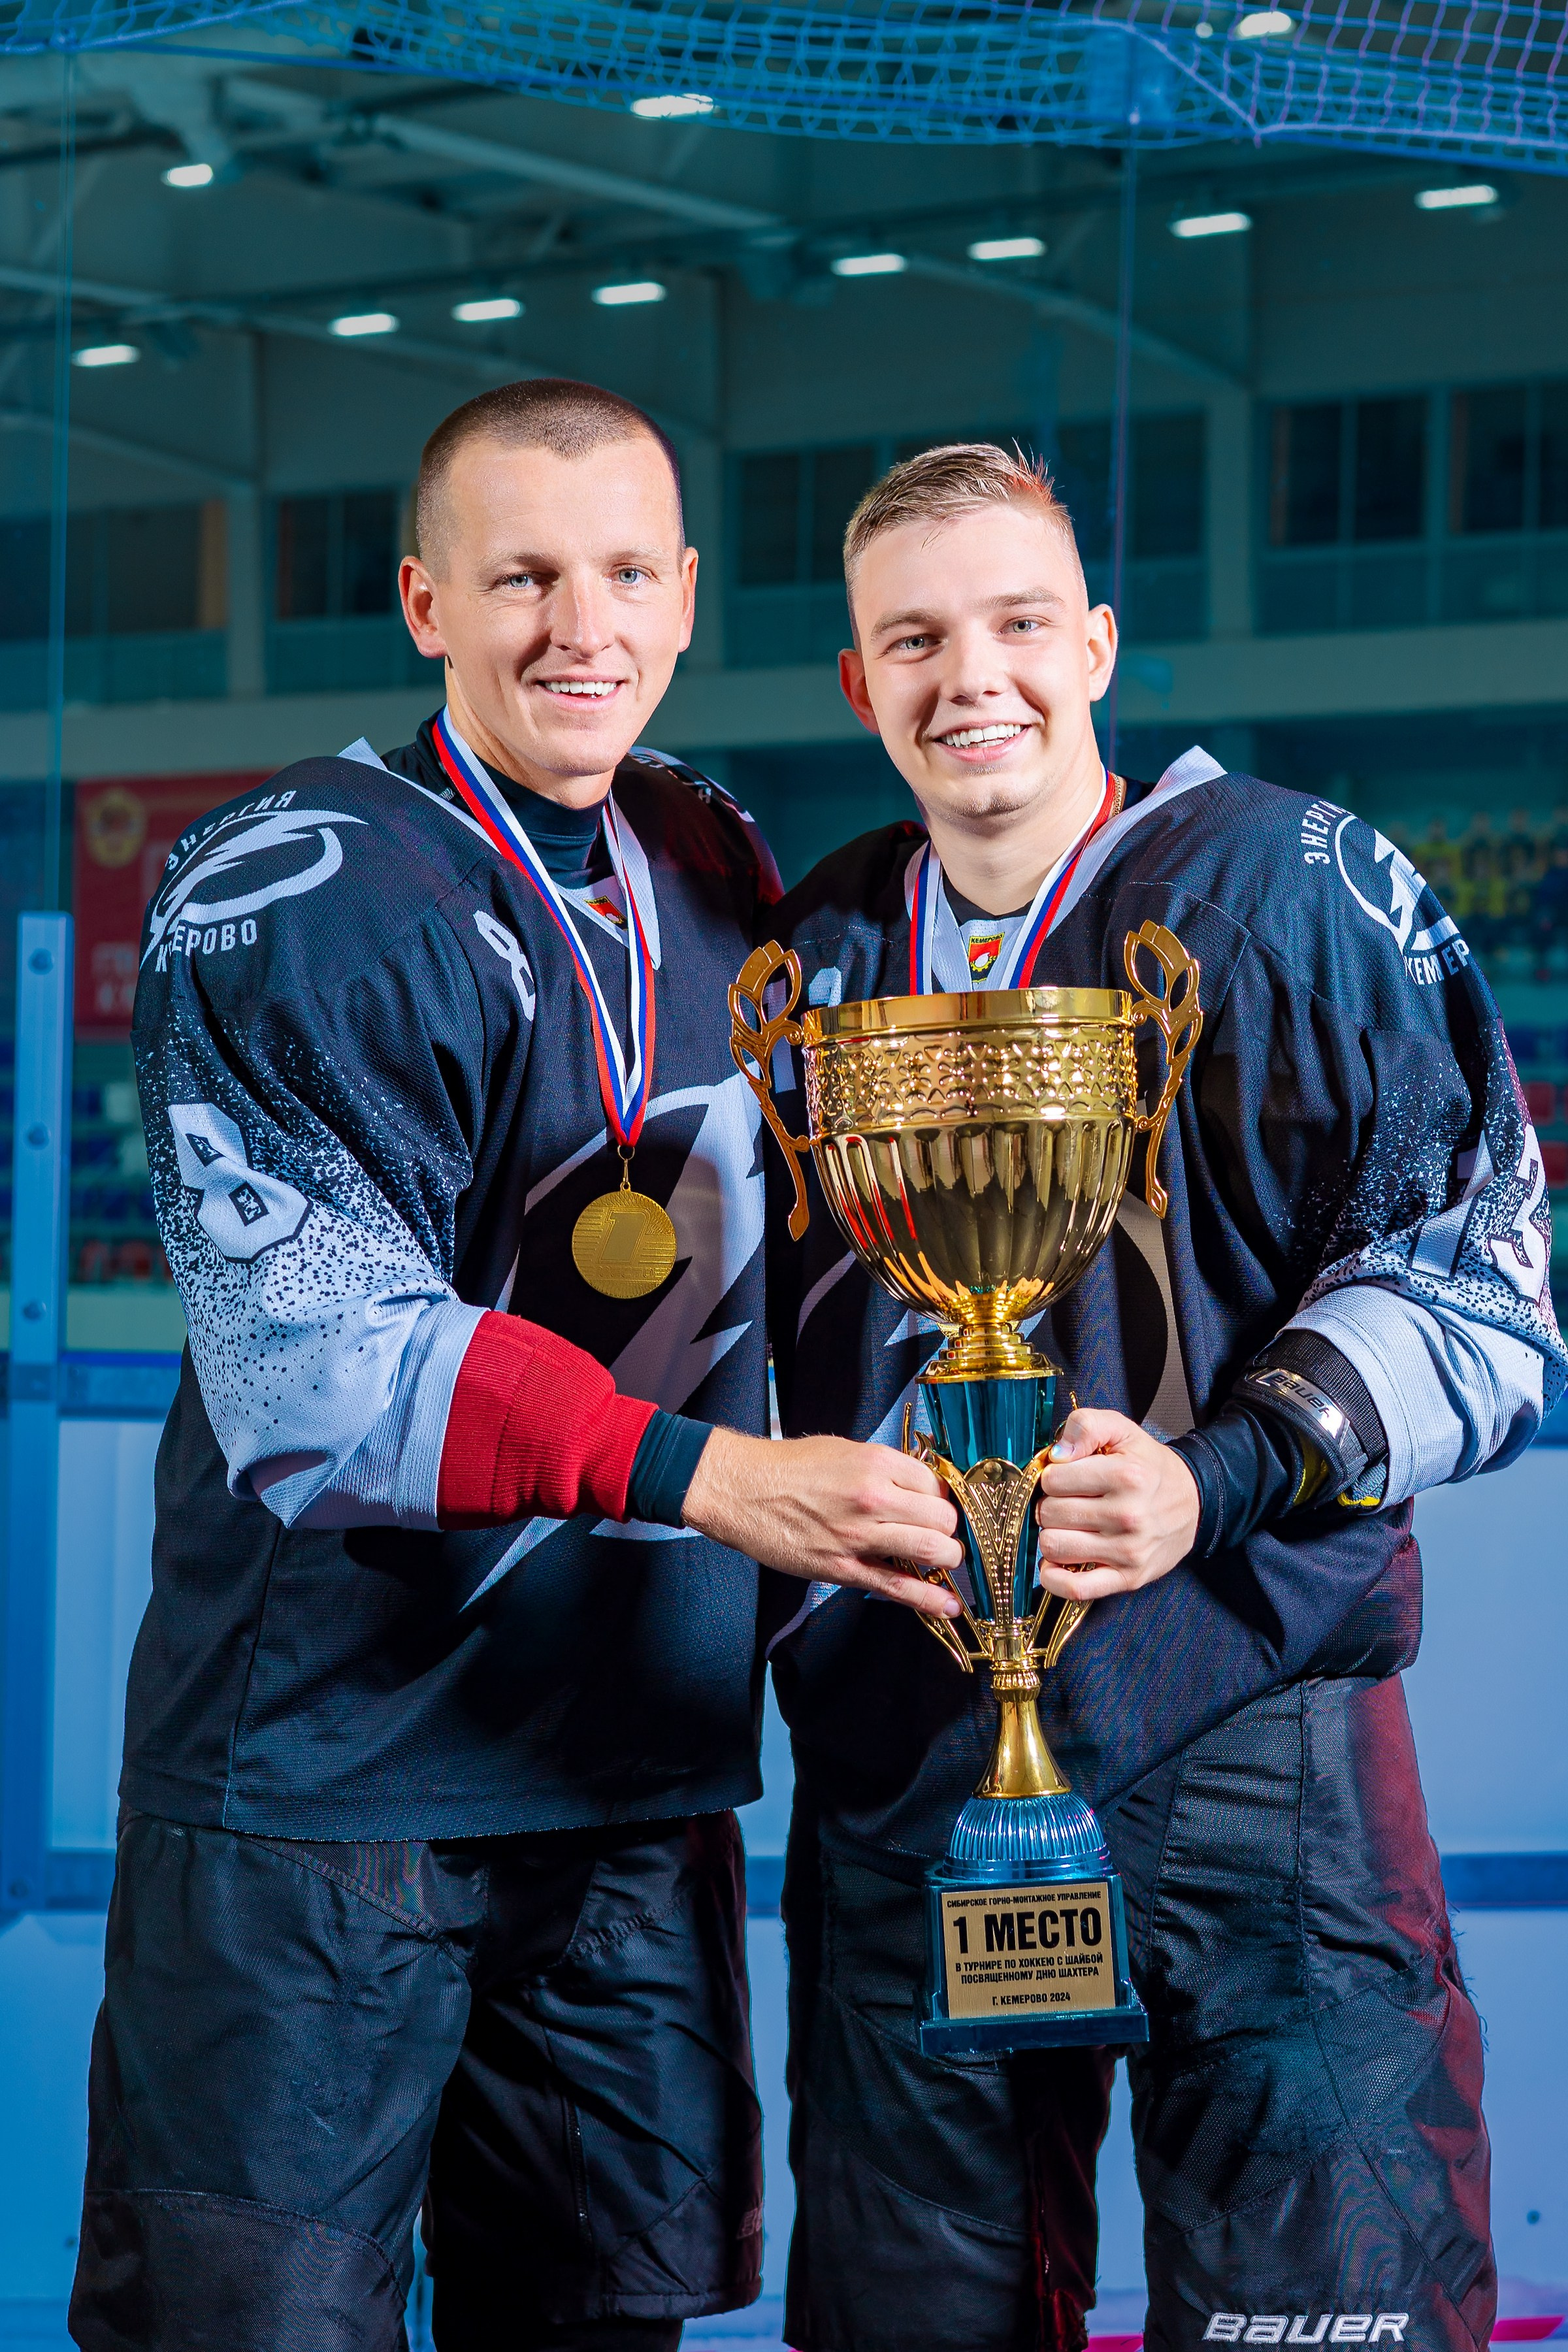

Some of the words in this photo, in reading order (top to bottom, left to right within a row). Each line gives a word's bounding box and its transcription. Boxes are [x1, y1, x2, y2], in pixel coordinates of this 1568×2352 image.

[164, 790, 297, 871] ЭНЕРГИЯ
[155, 919, 258, 973] КЕРОВО
[971, 934, 1003, 943] КЕМЕРОВО
[472, 909, 536, 1022] 8
[168, 1102, 314, 1265] 8
[947, 1899, 988, 1908] СИБИРСКОЕ
[988, 1893, 1056, 1906] ГОРНО-МОНТАЖНОЕ
[1056, 1891, 1102, 1901] УПРАВЛЕНИЕ
[953, 1916, 969, 1954] 1
[983, 1906, 1103, 1953] МЕСТО
[955, 1962, 962, 1972] В
[963, 1960, 1002, 1972] ТУРНИРЕ
[1004, 1959, 1017, 1969] ПО
[1019, 1955, 1055, 1968] ХОККЕЮ
[1056, 1955, 1063, 1965] С
[1065, 1951, 1103, 1965] ШАЙБОЙ
[960, 1970, 1034, 1985] ПОСВЯЩЕННОМУ
[1036, 1968, 1056, 1980] ДНЮ
[1058, 1966, 1100, 1979] ШАХТЕРА
[992, 1996, 999, 2006] Г.
[1000, 1993, 1048, 2006] КЕМЕРОВО
[1049, 1991, 1071, 2002] 2024
[1203, 2312, 1409, 2344] BAUER
